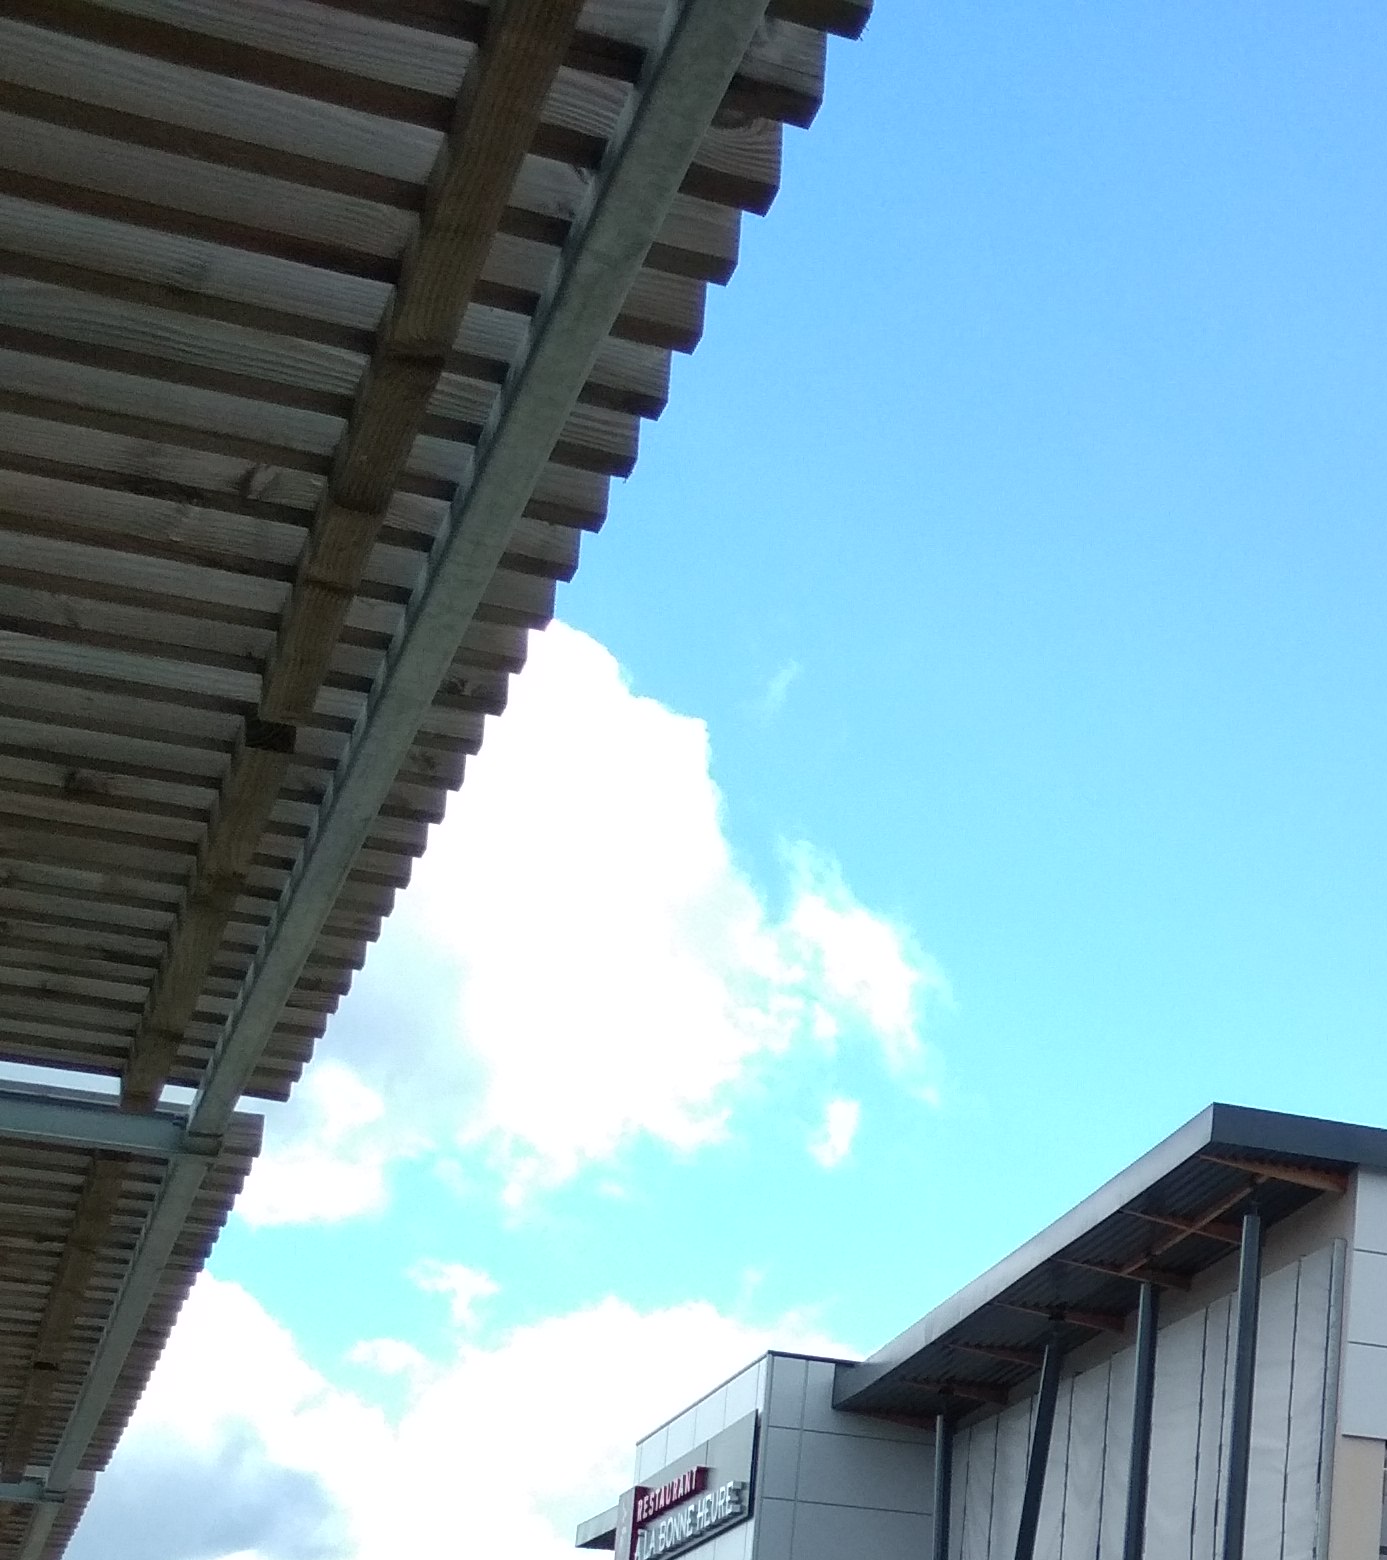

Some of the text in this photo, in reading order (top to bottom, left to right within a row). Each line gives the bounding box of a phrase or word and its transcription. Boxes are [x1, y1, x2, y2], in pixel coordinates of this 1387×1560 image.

[636, 1465, 705, 1523] RESTAURANT
[658, 1503, 695, 1552] BONNE
[696, 1480, 736, 1531] HEURE
